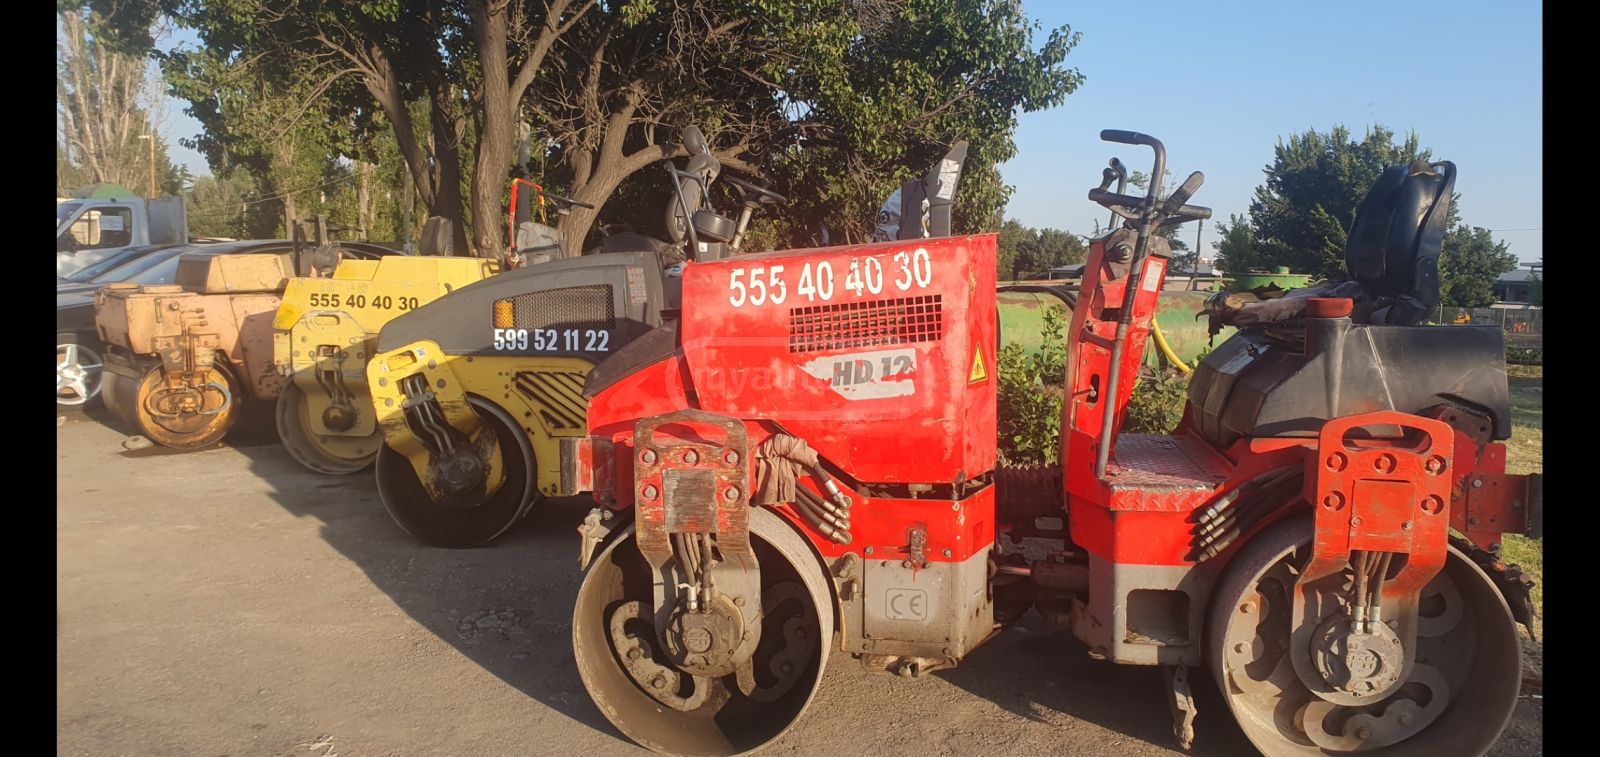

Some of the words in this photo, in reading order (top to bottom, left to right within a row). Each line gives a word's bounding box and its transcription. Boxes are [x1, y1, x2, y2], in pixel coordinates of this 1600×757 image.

[729, 265, 787, 308] 555
[797, 260, 835, 302] 40
[845, 255, 884, 297] 40
[893, 247, 932, 293] 30
[310, 293, 340, 308] 555
[346, 294, 366, 309] 40
[371, 295, 392, 310] 40
[398, 296, 419, 311] 30
[493, 328, 529, 351] 599
[534, 328, 558, 351] 52
[563, 329, 579, 351] 11
[584, 329, 609, 352] 22
[832, 358, 875, 387] HD
[881, 355, 914, 382] 12
[890, 593, 922, 616] CE
